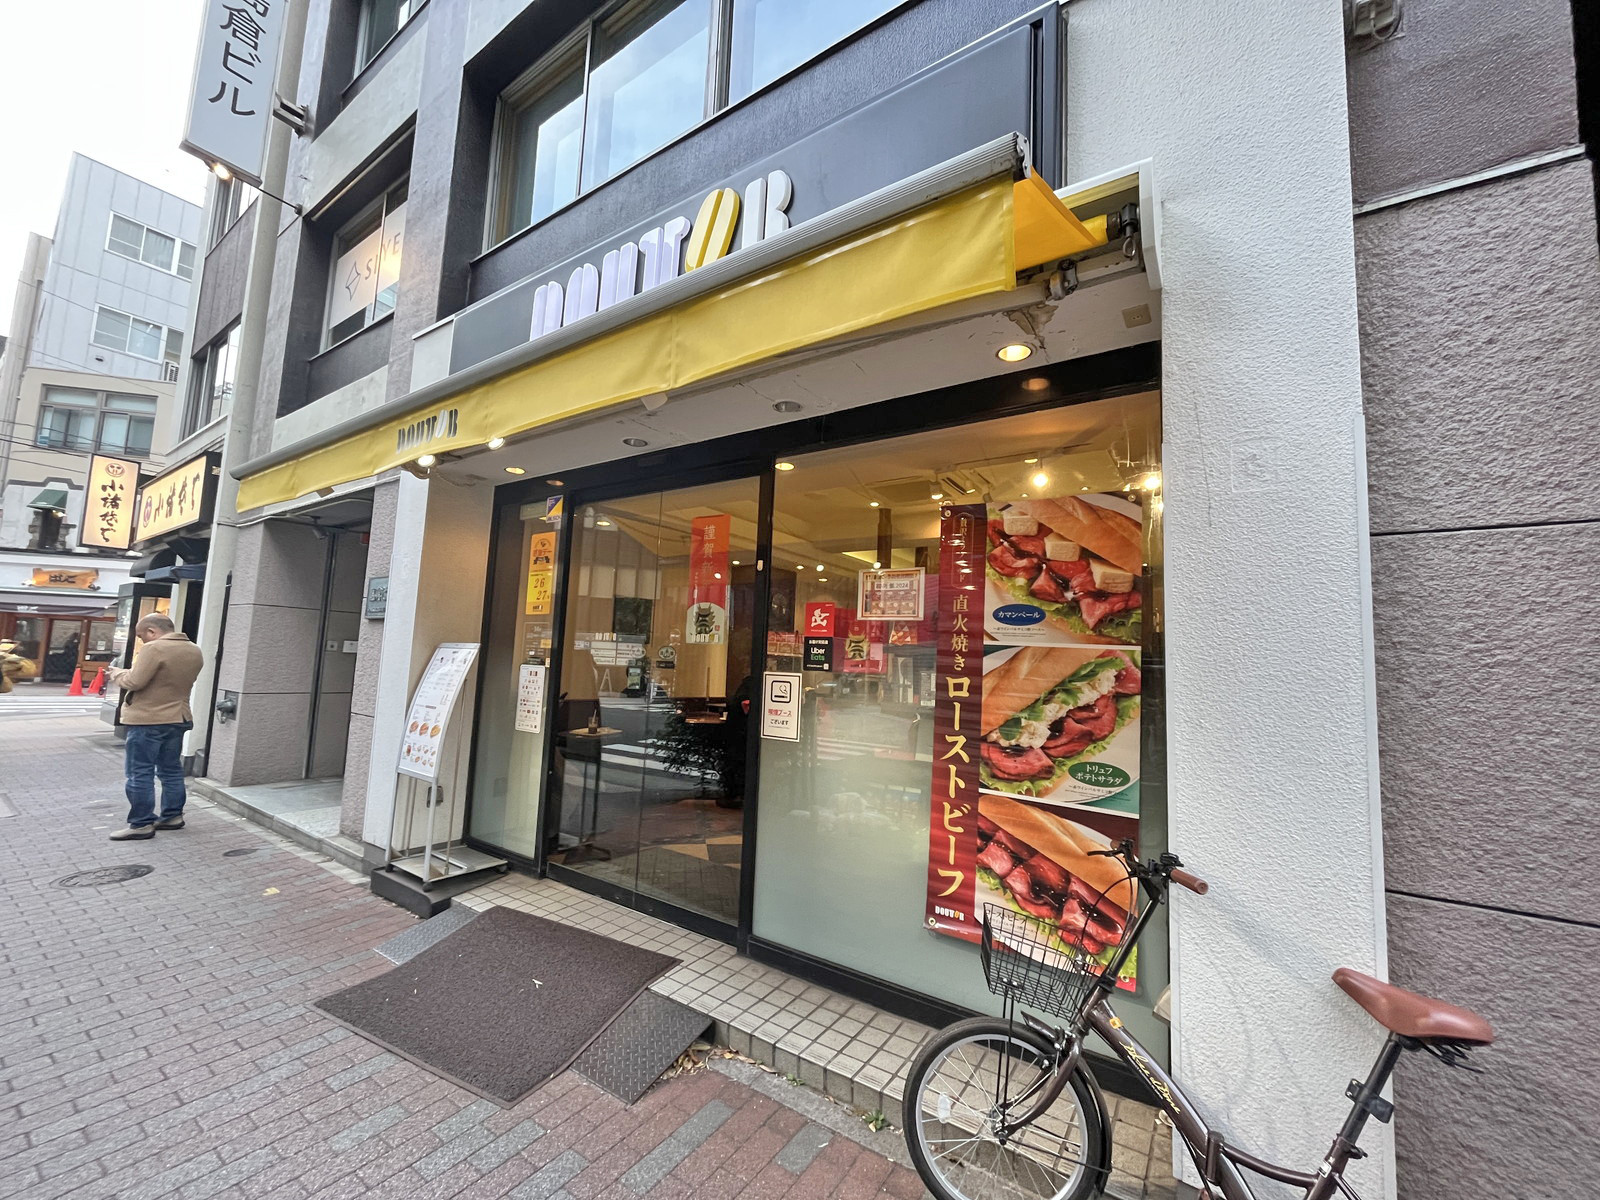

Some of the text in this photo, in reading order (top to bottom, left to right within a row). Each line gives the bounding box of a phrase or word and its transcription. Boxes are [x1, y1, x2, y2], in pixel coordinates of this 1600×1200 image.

[529, 169, 792, 342] DOUTOR
[396, 408, 459, 453] DOUTOR
[998, 611, 1041, 619] カマンベール
[952, 594, 969, 671] 直火焼き
[810, 647, 826, 655] Uber
[1086, 764, 1113, 775] トリュフ
[937, 676, 971, 897] ローストビーフ
[1075, 772, 1124, 786] ポテトサラダ
[934, 905, 965, 921] DOUTOR
